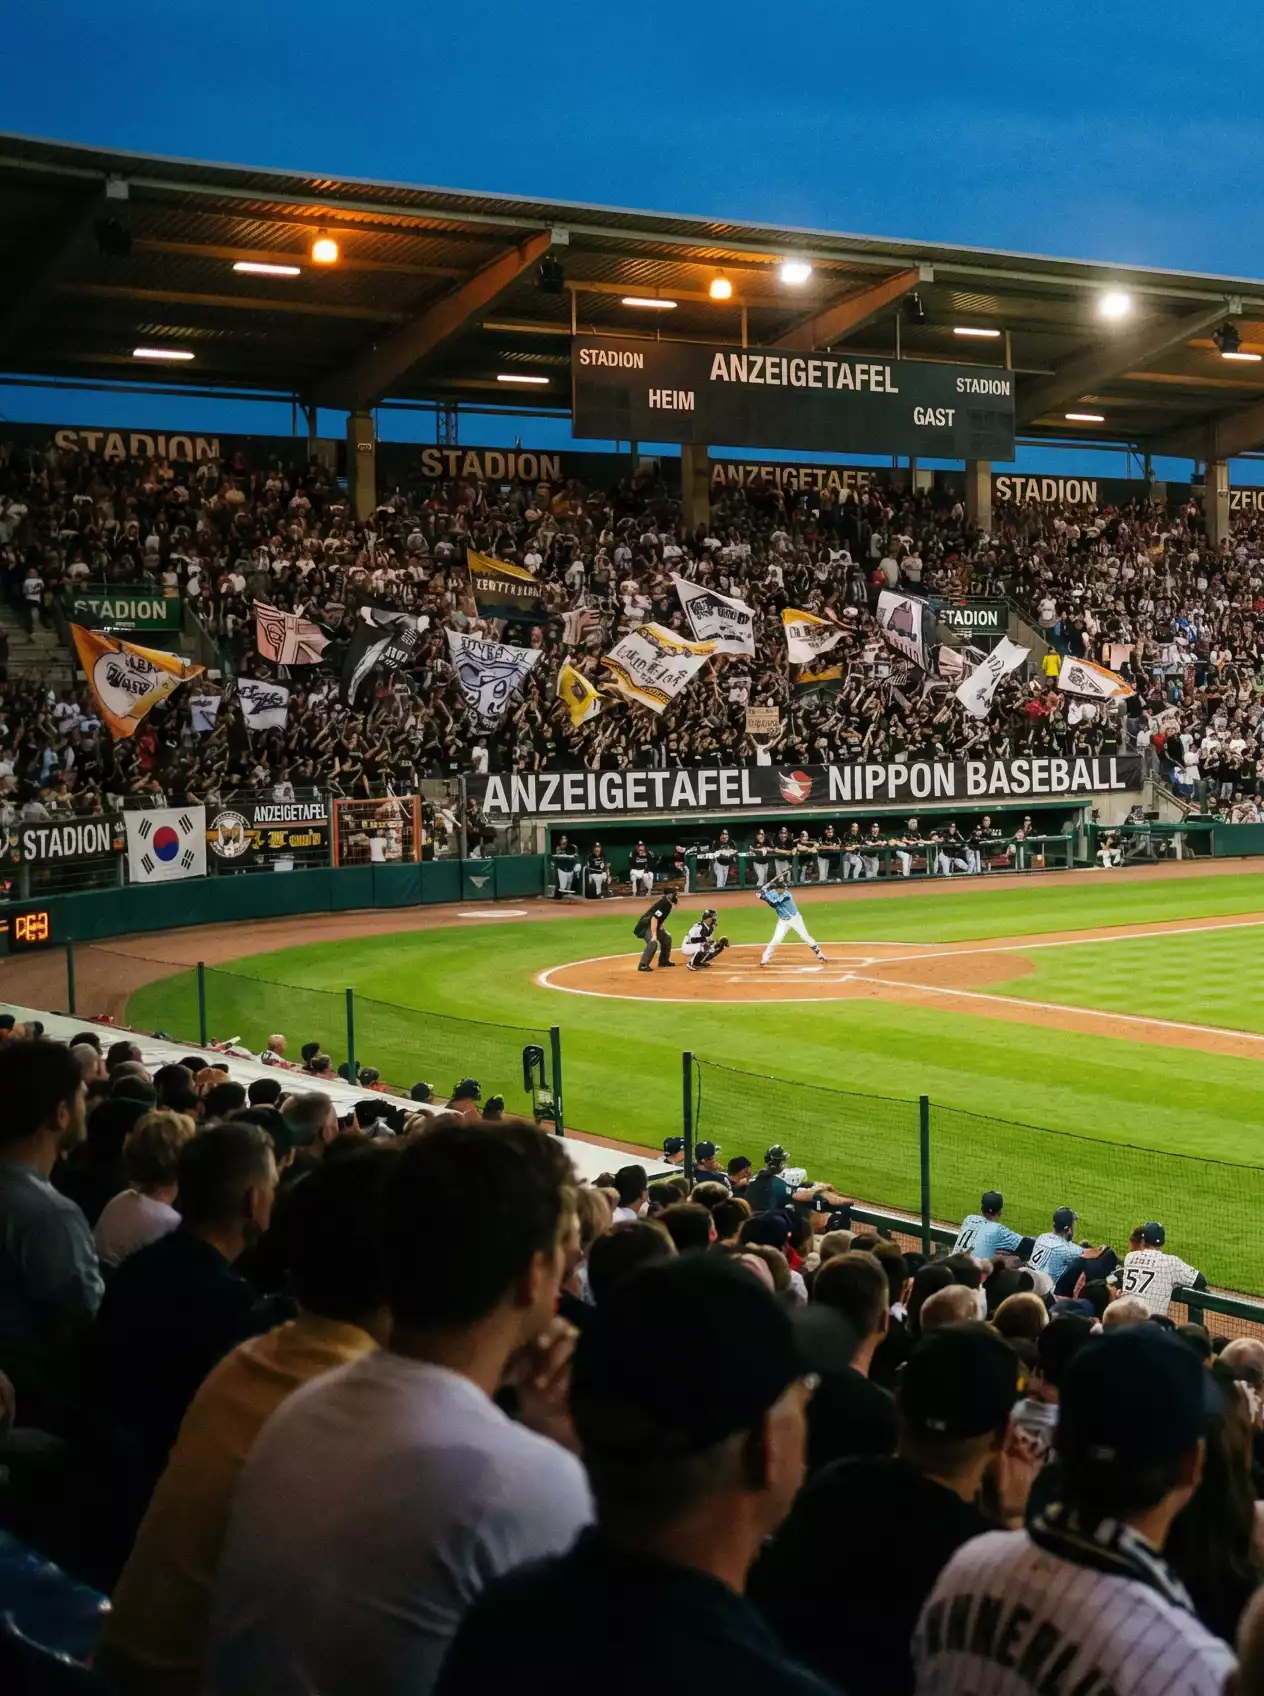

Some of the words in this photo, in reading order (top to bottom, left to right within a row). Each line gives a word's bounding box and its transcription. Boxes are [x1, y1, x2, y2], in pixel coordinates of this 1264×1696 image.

[579, 348, 644, 369] STADION
[709, 352, 899, 394] ANZEIGETAFEL
[648, 388, 695, 411] HEIM
[956, 377, 1010, 396] STADION
[913, 406, 956, 427] GAST
[54, 429, 220, 463] STADION
[421, 448, 562, 482] STADION
[709, 463, 877, 492] ANZEIGETAFE
[995, 476, 1098, 504] STADION
[74, 600, 167, 619] STADION
[482, 769, 763, 813] ANZEIGETAFEL
[828, 762, 955, 801] NIPPON
[966, 757, 1127, 796] BASEBALL
[253, 803, 329, 822] ANZEIGETAFEL
[23, 822, 111, 860] STADION
[1125, 1268, 1156, 1293] 57
